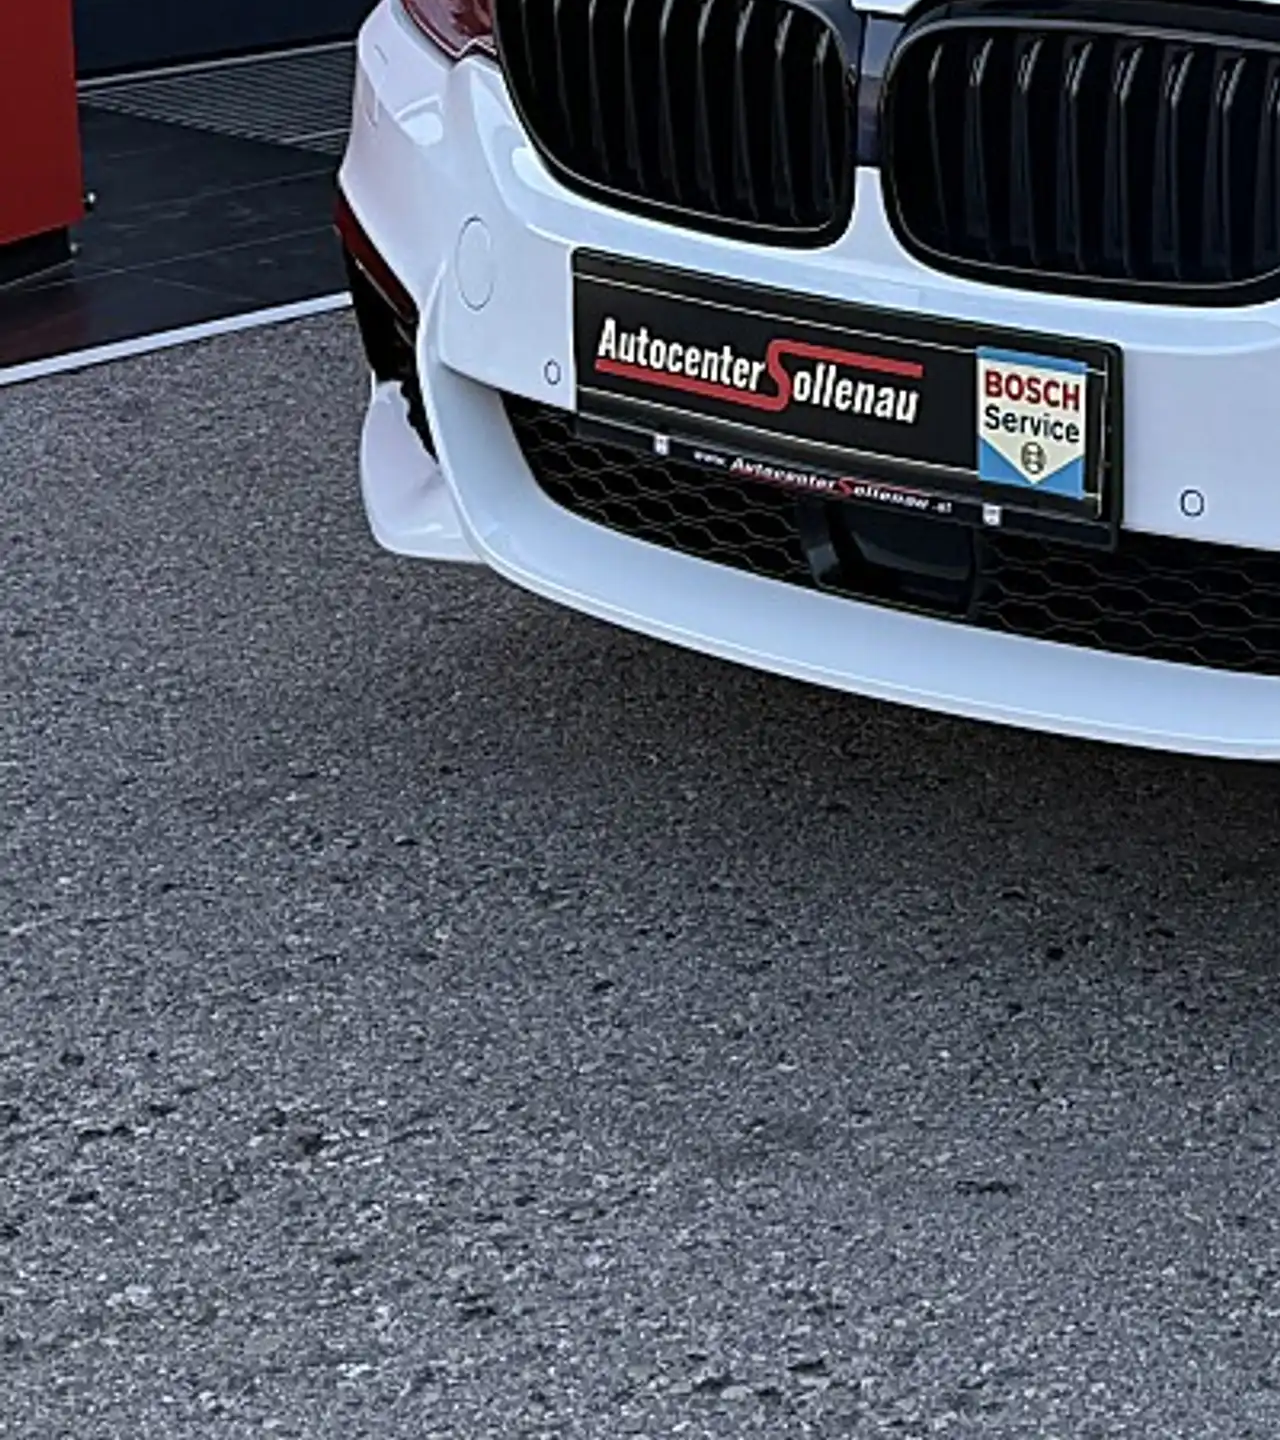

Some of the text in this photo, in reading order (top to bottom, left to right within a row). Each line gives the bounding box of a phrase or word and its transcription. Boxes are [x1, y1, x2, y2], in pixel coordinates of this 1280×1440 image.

[597, 316, 768, 393] Autocenter
[984, 368, 1081, 412] BOSCH
[983, 402, 1081, 444] Service
